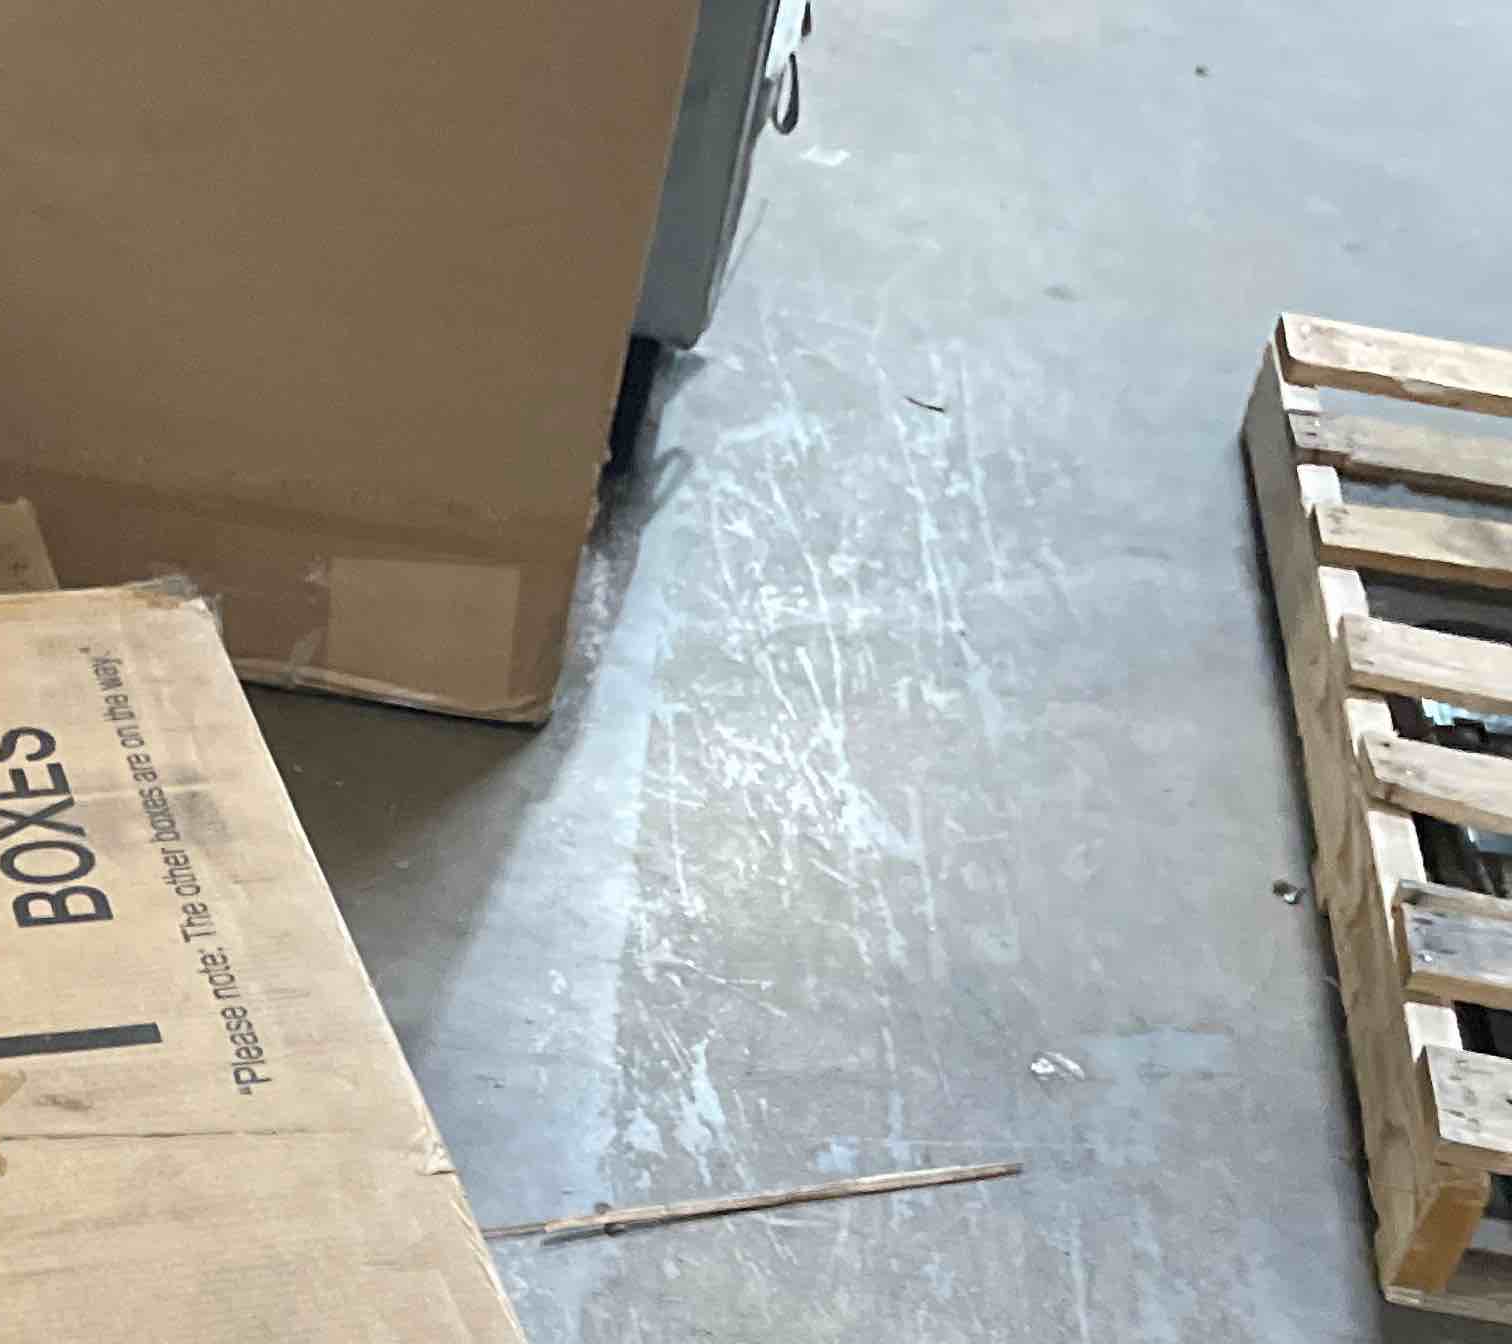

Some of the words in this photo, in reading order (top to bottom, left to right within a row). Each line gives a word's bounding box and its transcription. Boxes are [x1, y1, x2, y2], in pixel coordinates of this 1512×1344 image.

[104, 694, 135, 721] the
[116, 725, 145, 749] on
[126, 754, 157, 782] are
[140, 786, 180, 843] boxes
[161, 848, 200, 896] other
[180, 902, 216, 943] The
[198, 948, 240, 999] note:
